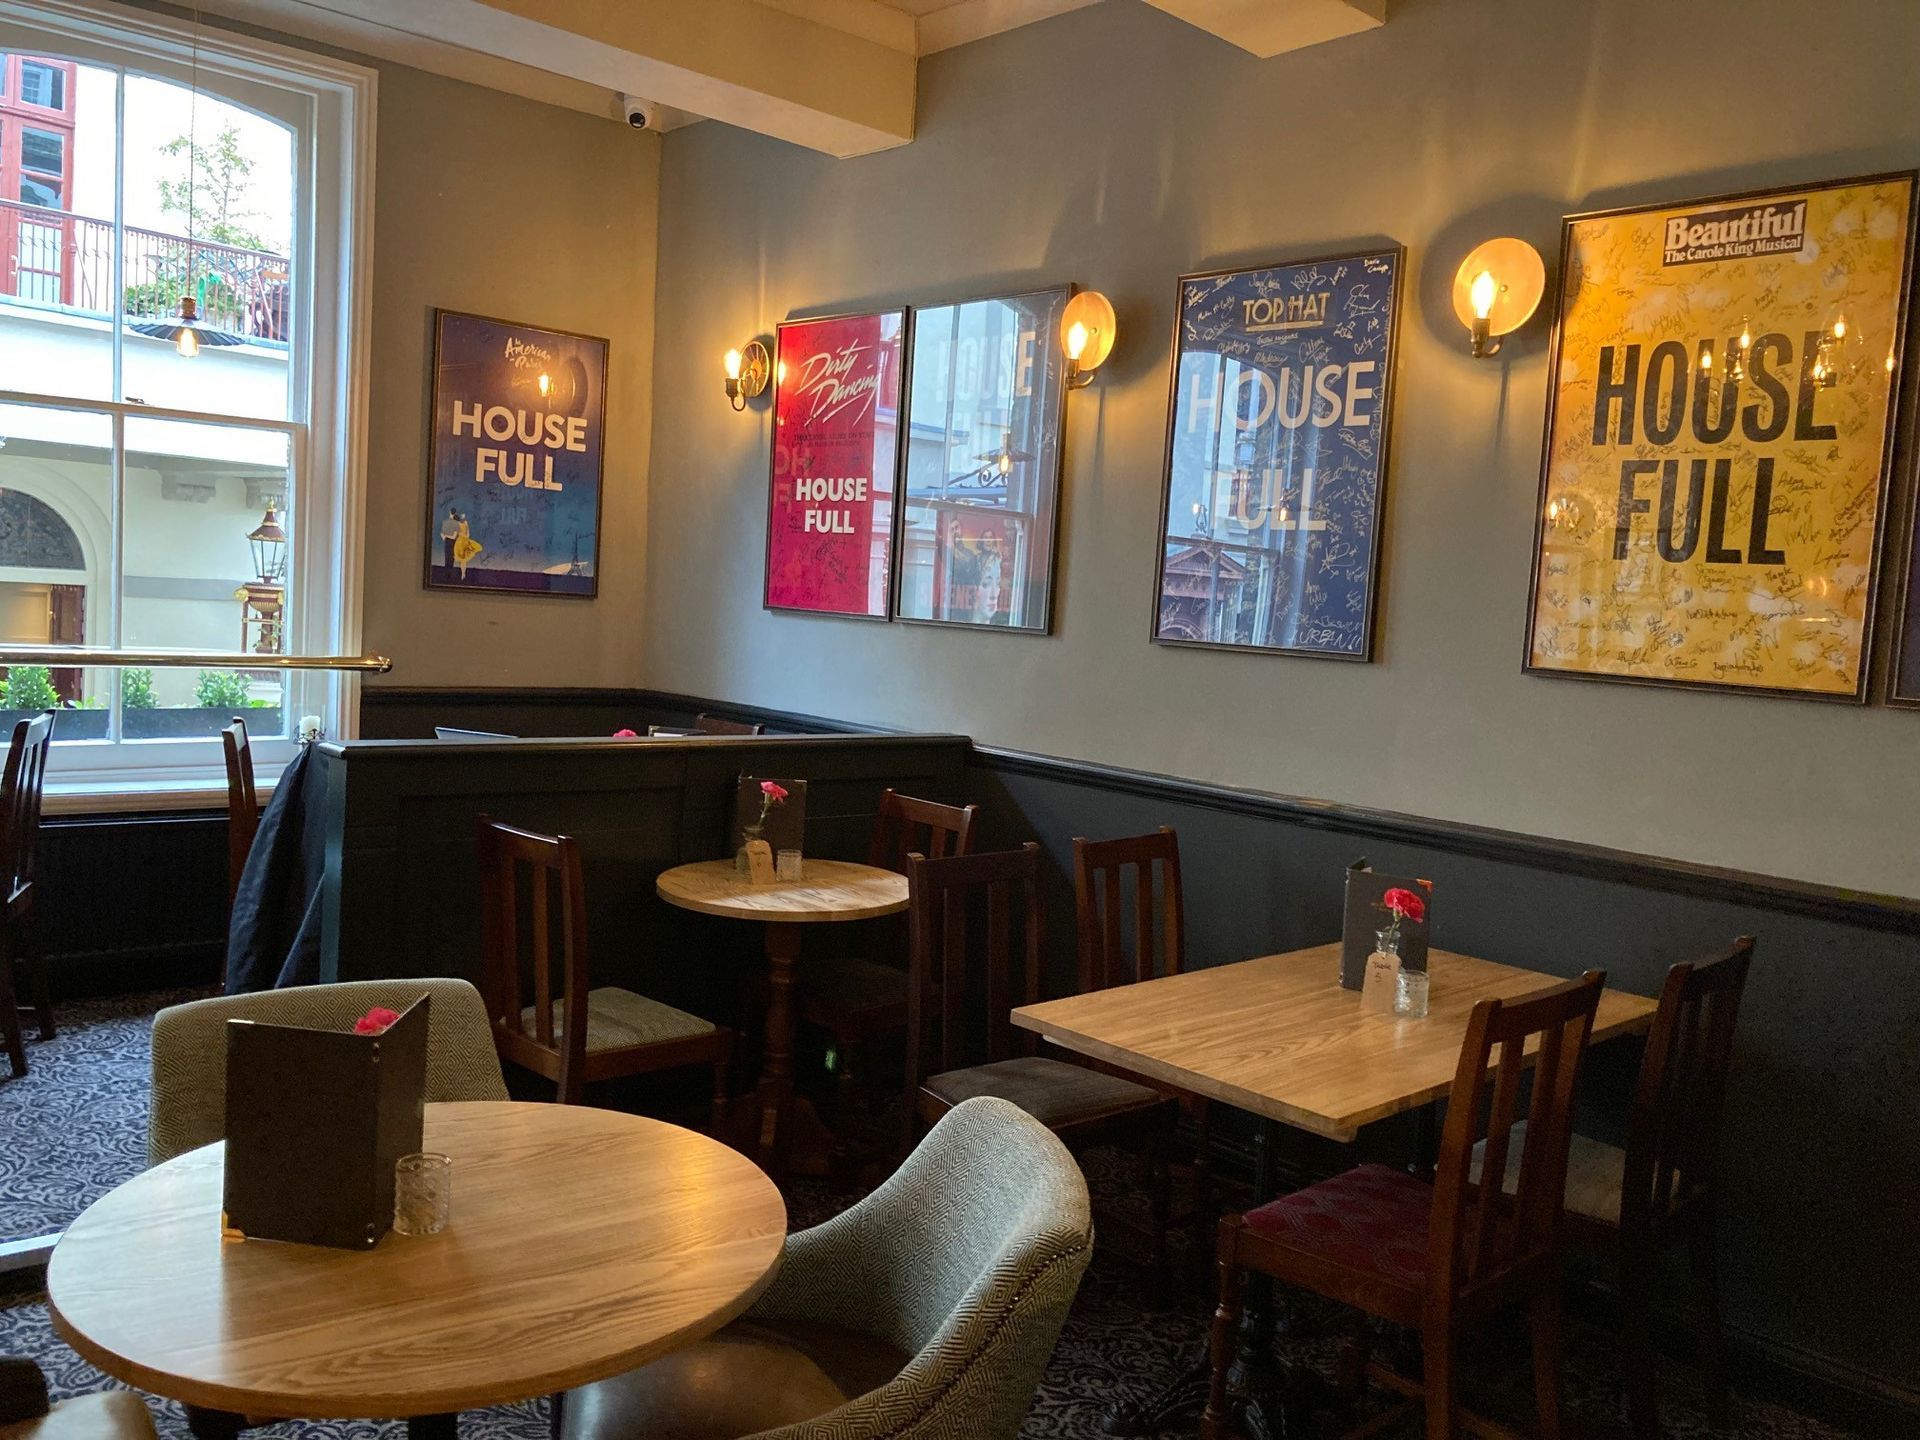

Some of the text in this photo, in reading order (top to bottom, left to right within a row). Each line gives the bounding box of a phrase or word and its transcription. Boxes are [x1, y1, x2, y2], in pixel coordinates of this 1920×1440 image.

[1665, 203, 1806, 250] Beautiful
[1665, 236, 1802, 263] The Carole King Musical
[1243, 298, 1284, 324] TOP
[1288, 292, 1330, 321] HAT
[794, 338, 872, 396] Dirty
[1592, 330, 1838, 446] HOUSE
[804, 365, 880, 428] Dancing
[1187, 361, 1375, 433] HOUSE
[453, 400, 587, 452] HOUSE
[475, 447, 563, 492] FULL
[796, 478, 867, 502] HOUSE
[804, 510, 854, 534] FULL
[1613, 457, 1787, 565] FULL
